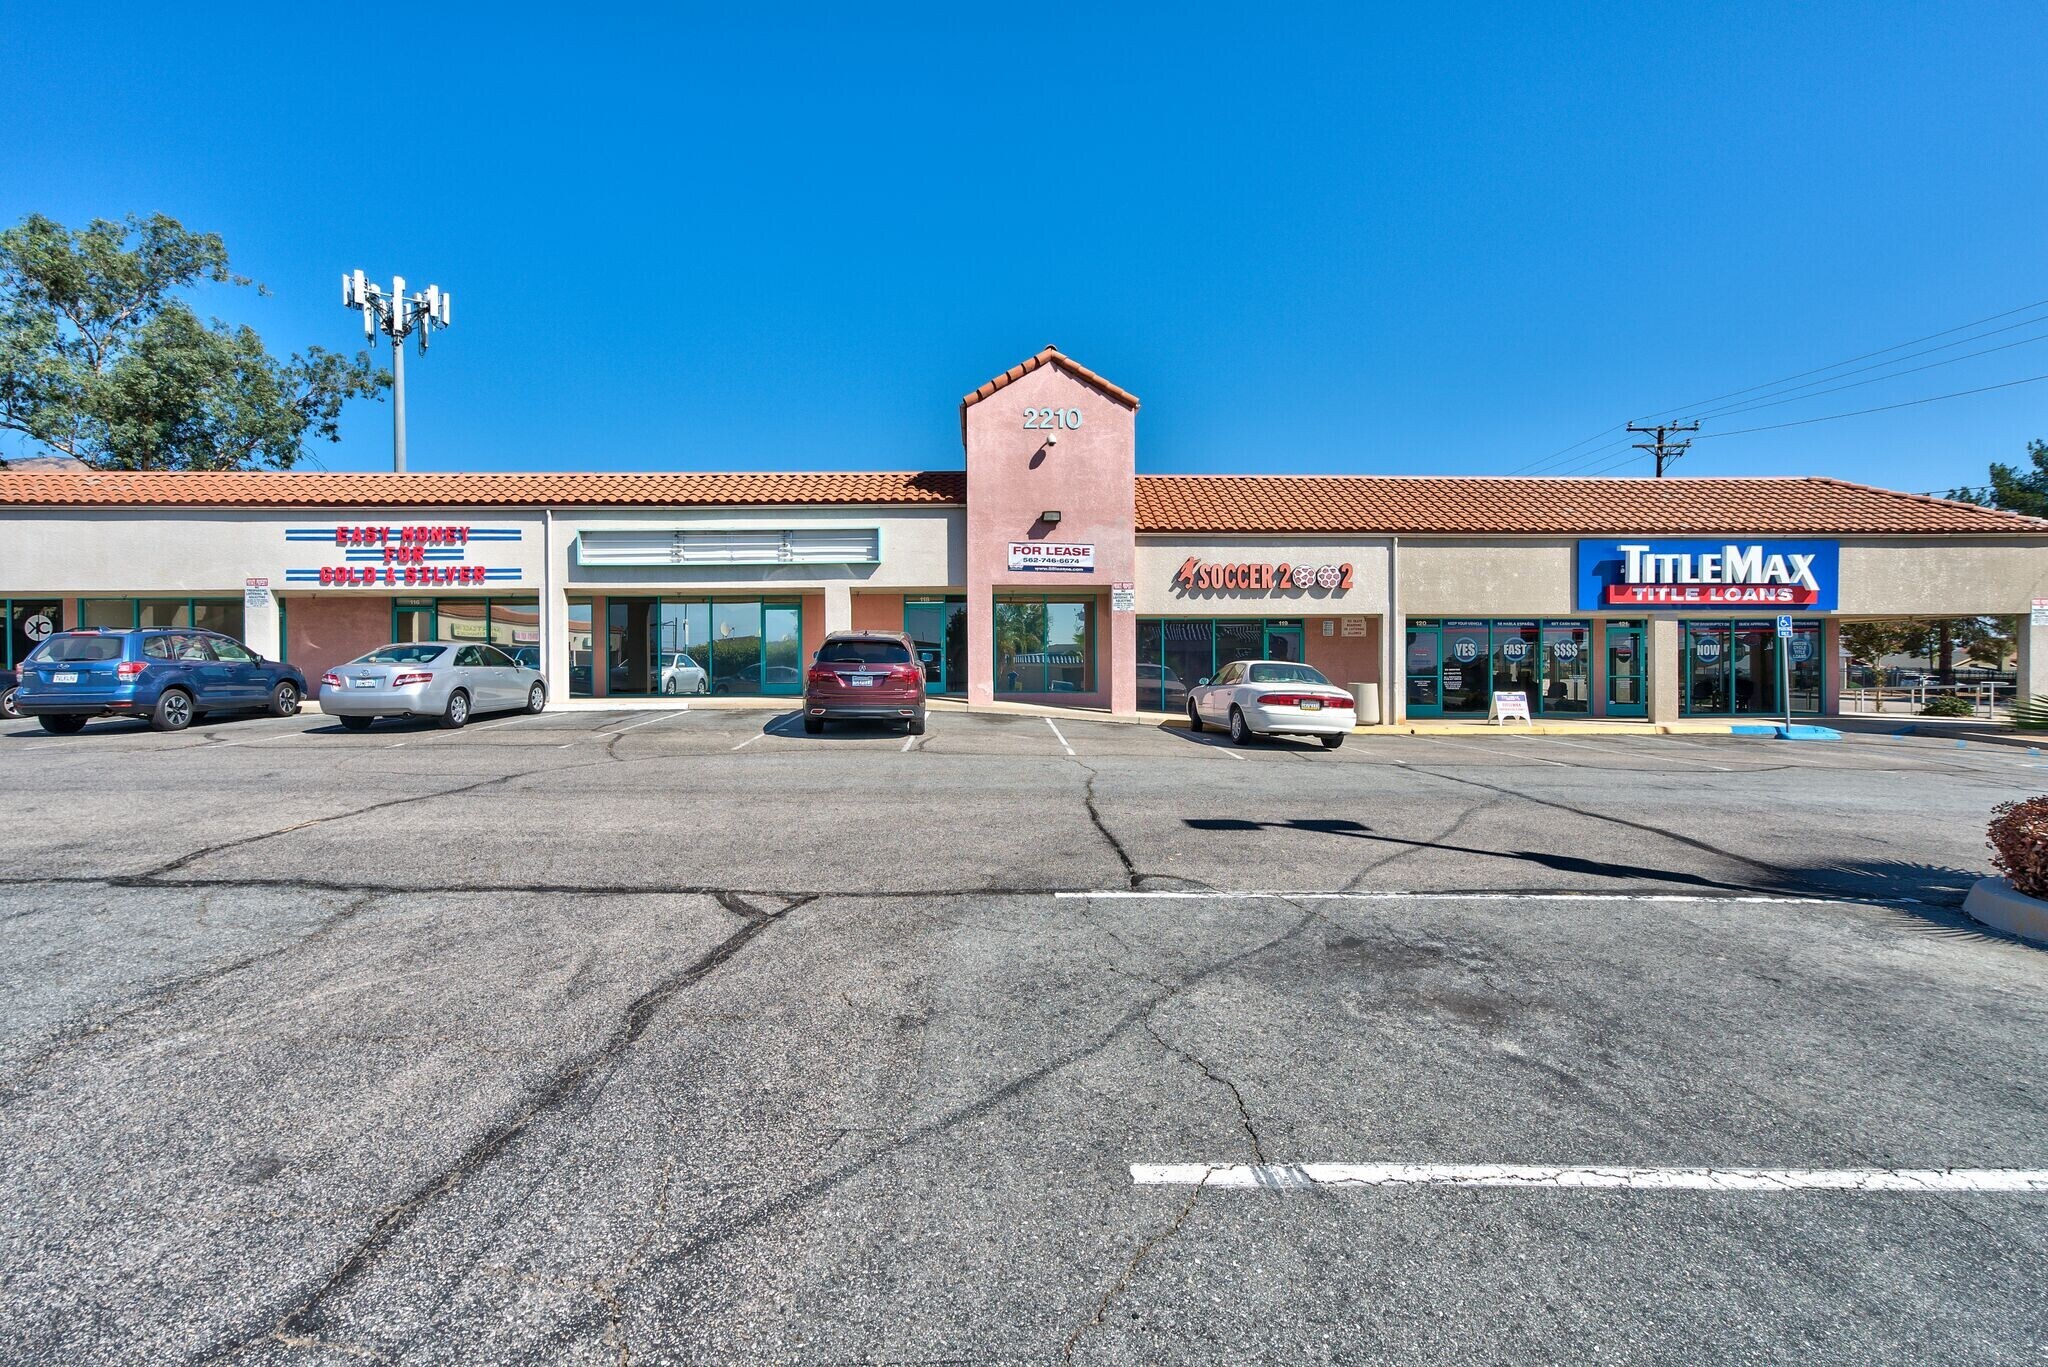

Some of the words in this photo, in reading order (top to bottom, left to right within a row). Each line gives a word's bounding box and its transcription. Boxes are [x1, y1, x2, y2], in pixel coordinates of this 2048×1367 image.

[1023, 407, 1083, 430] 2210
[335, 526, 390, 543] EASY
[400, 526, 470, 543] MONEY
[383, 546, 426, 563] FOR
[1013, 546, 1041, 555] FOR
[1046, 547, 1091, 556] LEASE
[319, 566, 377, 583] GOLD
[384, 567, 398, 583] &
[404, 566, 487, 583] SILVER
[1198, 563, 1274, 590] SOCCER
[1632, 587, 1700, 601] TITLE
[1710, 587, 1794, 602] LOANS
[1455, 643, 1475, 656] YES
[1503, 644, 1527, 655] FAST
[1554, 643, 1578, 657] $$$$
[1696, 644, 1720, 656] NOW
